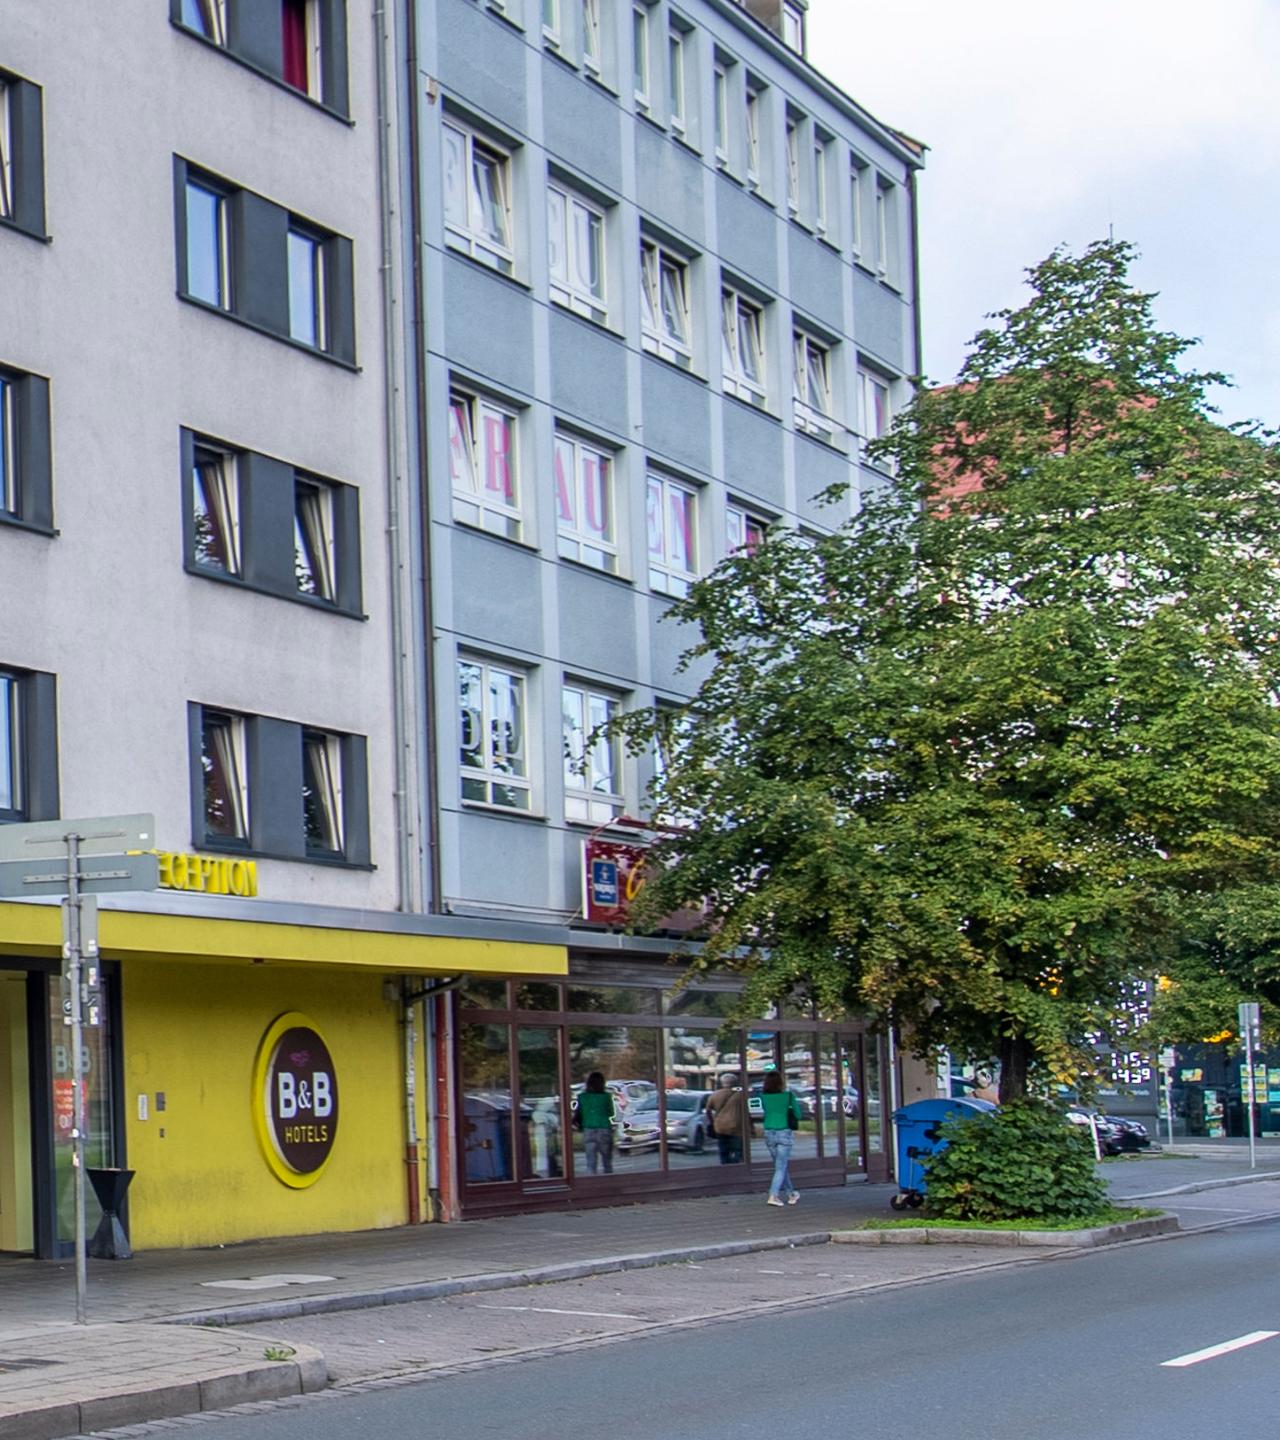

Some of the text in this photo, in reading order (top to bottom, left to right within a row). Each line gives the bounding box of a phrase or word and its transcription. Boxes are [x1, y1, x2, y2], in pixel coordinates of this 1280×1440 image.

[140, 849, 257, 897] ECEPTION
[278, 1072, 332, 1118] B&B
[285, 1125, 328, 1143] HOTELS
